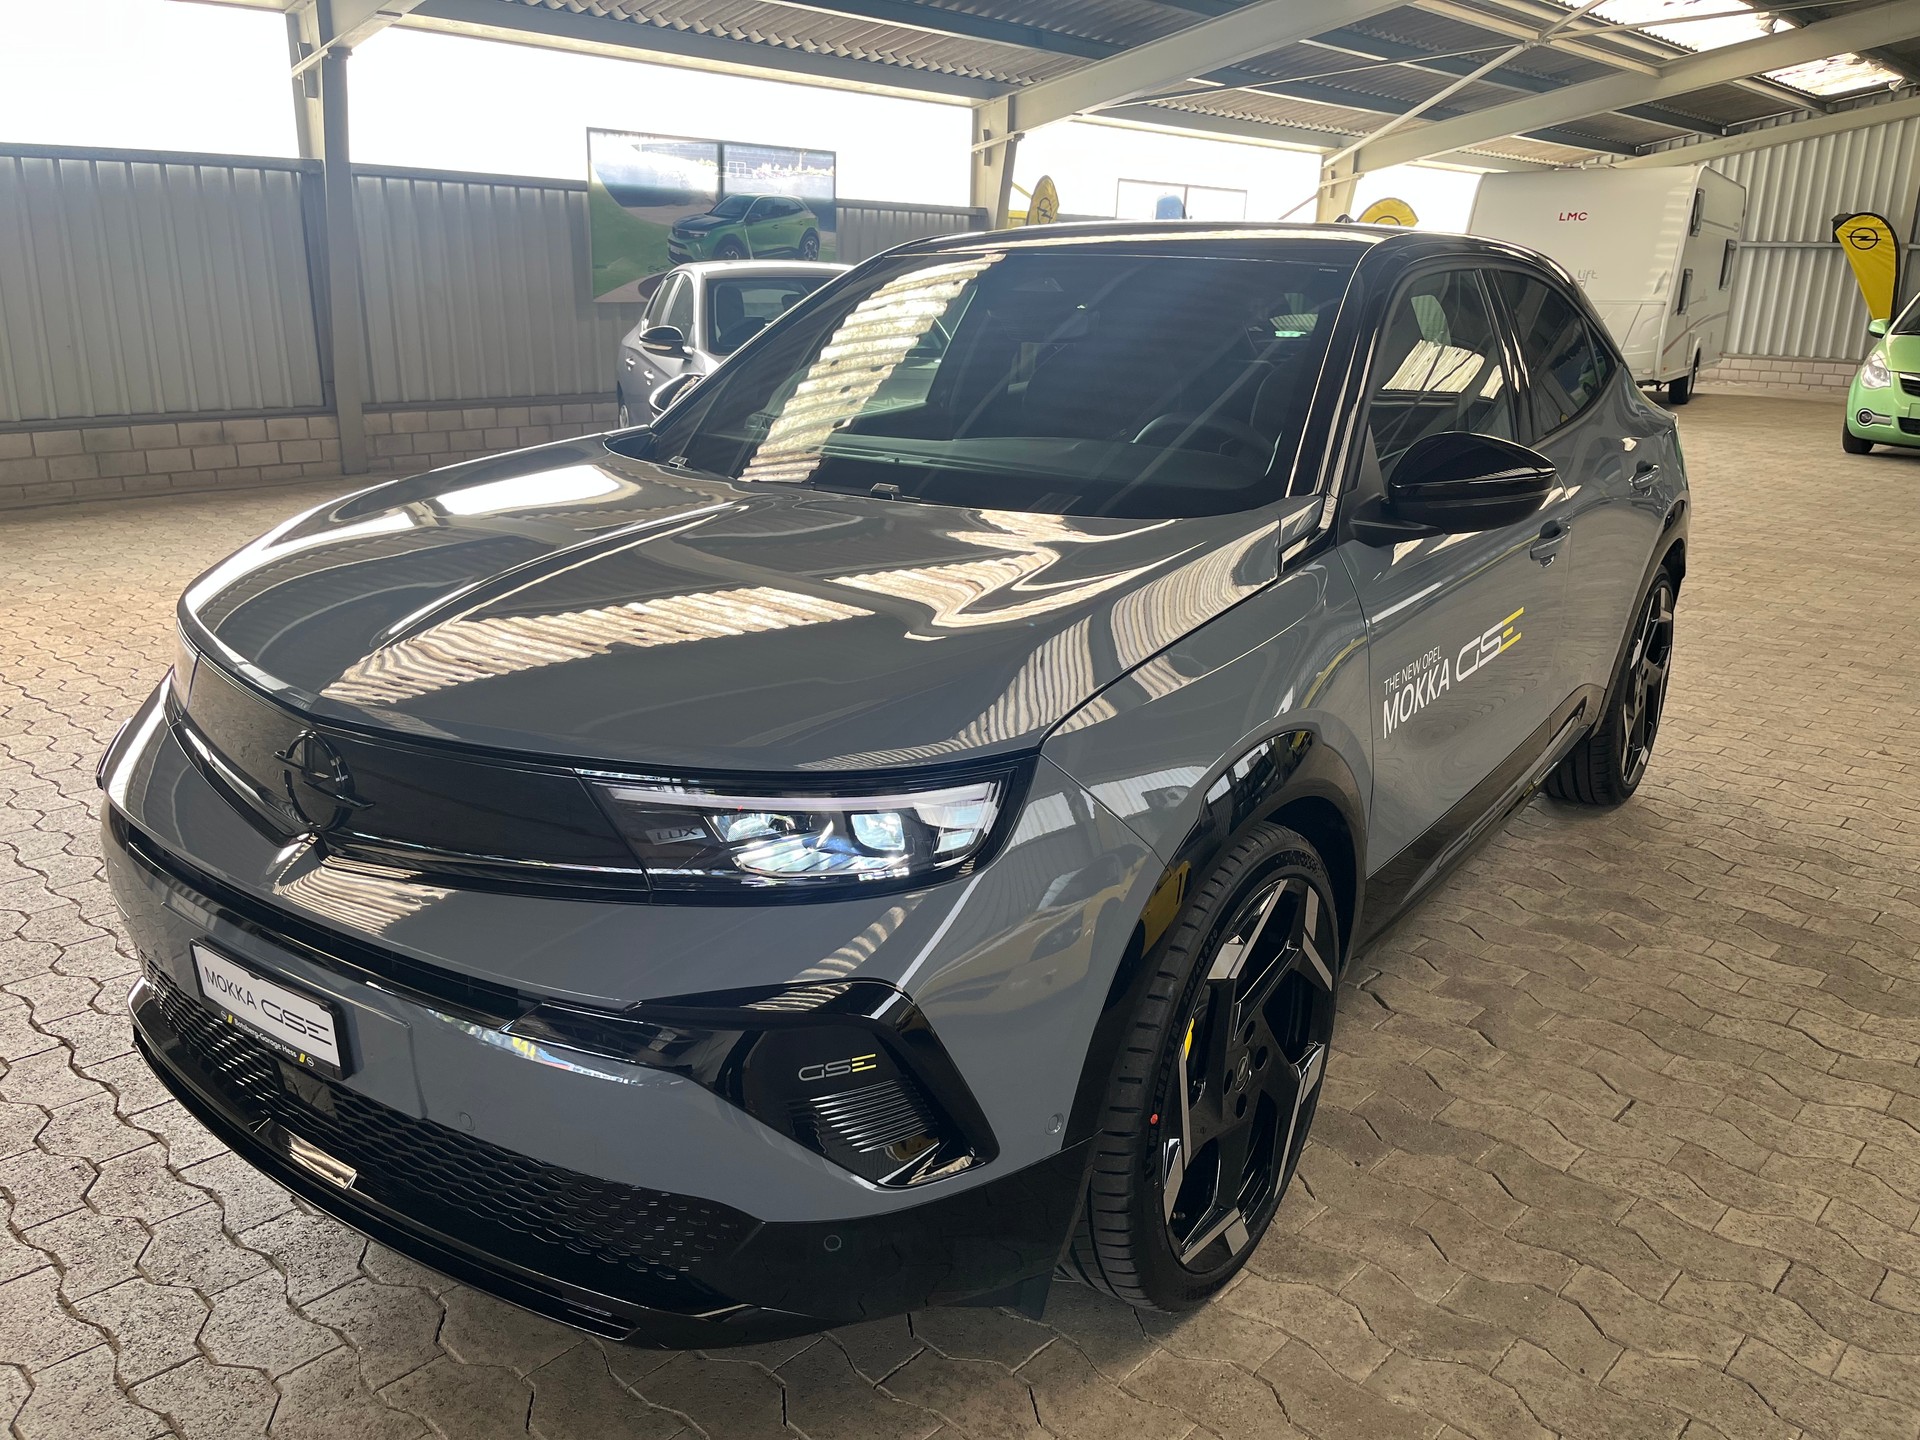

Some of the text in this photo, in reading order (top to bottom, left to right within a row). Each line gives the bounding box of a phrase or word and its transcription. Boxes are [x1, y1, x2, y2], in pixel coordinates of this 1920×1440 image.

[1558, 211, 1588, 221] LMC
[1383, 606, 1525, 739] MOKKA GSE
[1384, 646, 1442, 695] THE NEW OPEL
[657, 827, 697, 840] LUX
[204, 966, 332, 1046] MOKKA GSE
[798, 1053, 877, 1081] GSE
